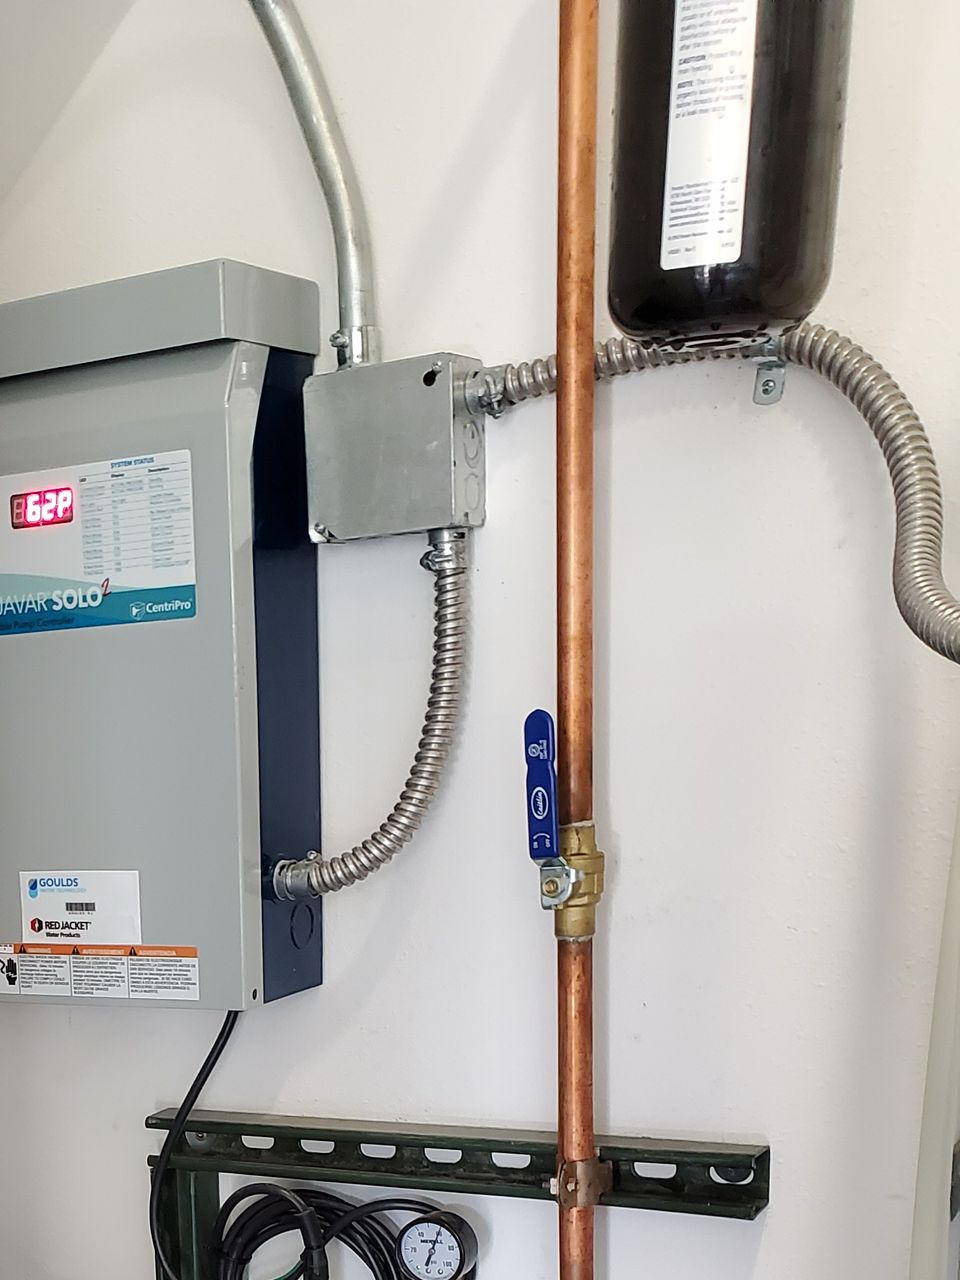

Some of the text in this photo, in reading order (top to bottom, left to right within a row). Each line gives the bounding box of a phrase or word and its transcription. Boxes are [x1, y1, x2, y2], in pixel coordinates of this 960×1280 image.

[26, 490, 72, 522] 62P
[146, 599, 191, 614] CentriPro
[39, 878, 79, 888] GOULDS
[44, 921, 60, 930] RED
